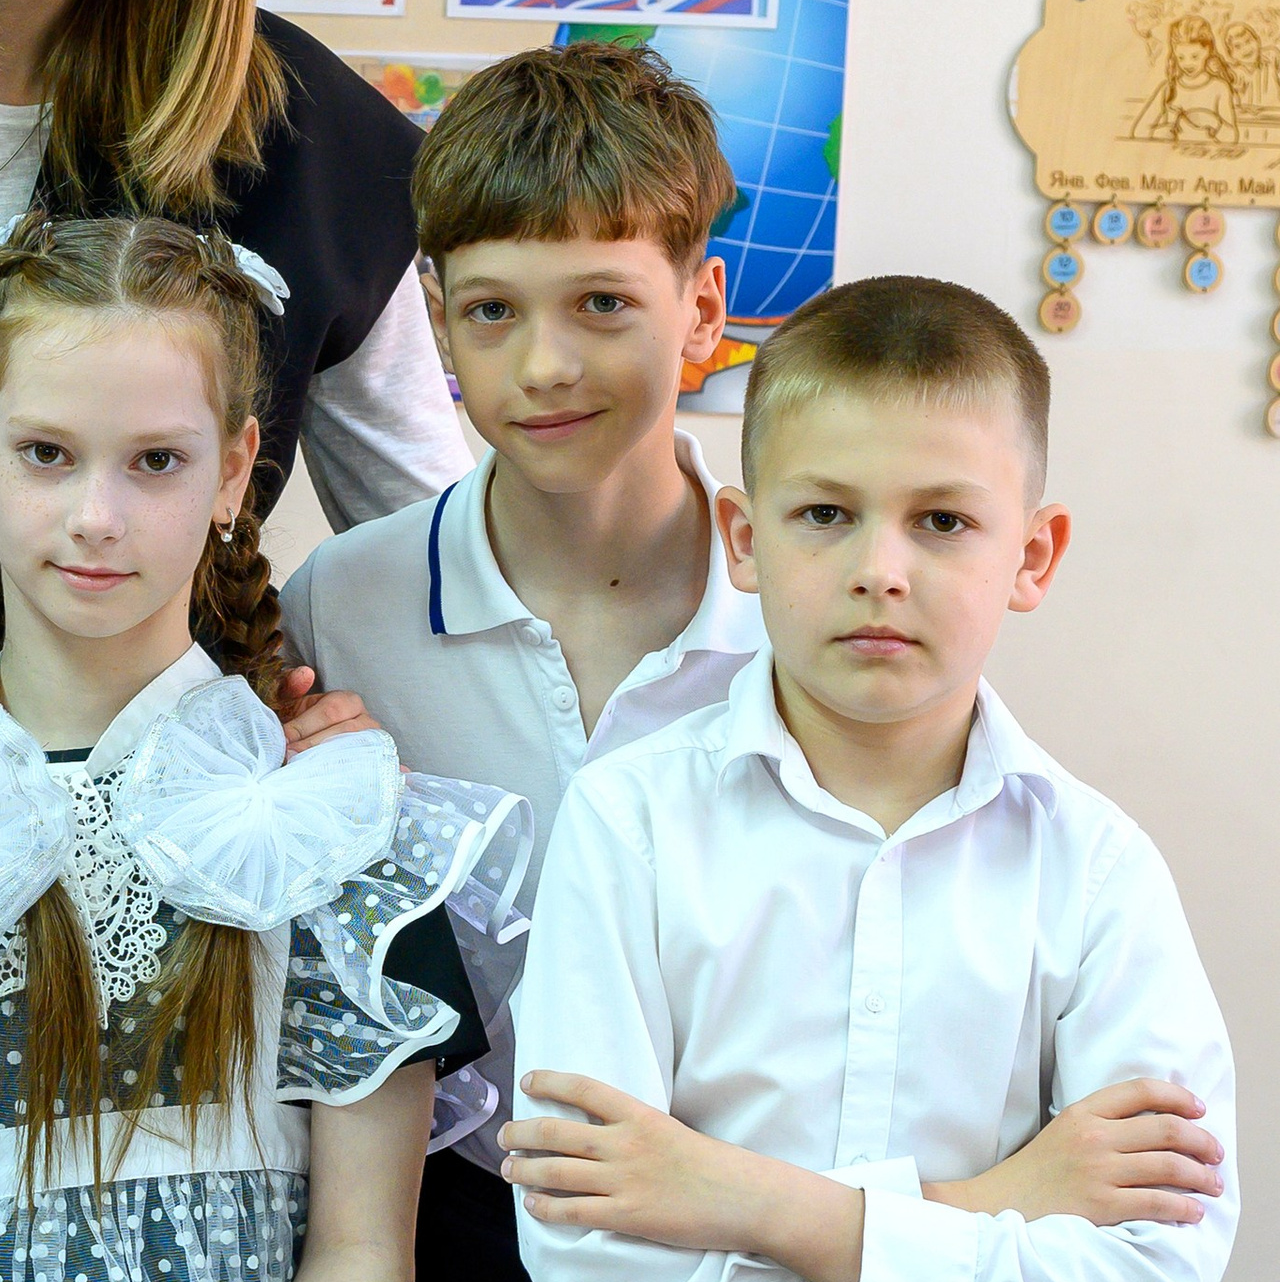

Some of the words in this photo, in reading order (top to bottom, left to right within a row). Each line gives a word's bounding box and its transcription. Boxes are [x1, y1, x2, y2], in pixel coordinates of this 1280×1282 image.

[1050, 170, 1088, 190] Янв.
[1095, 173, 1135, 191] Фев.
[1140, 174, 1185, 195] Март
[1194, 177, 1232, 197] Апр.
[1239, 177, 1275, 195] Май
